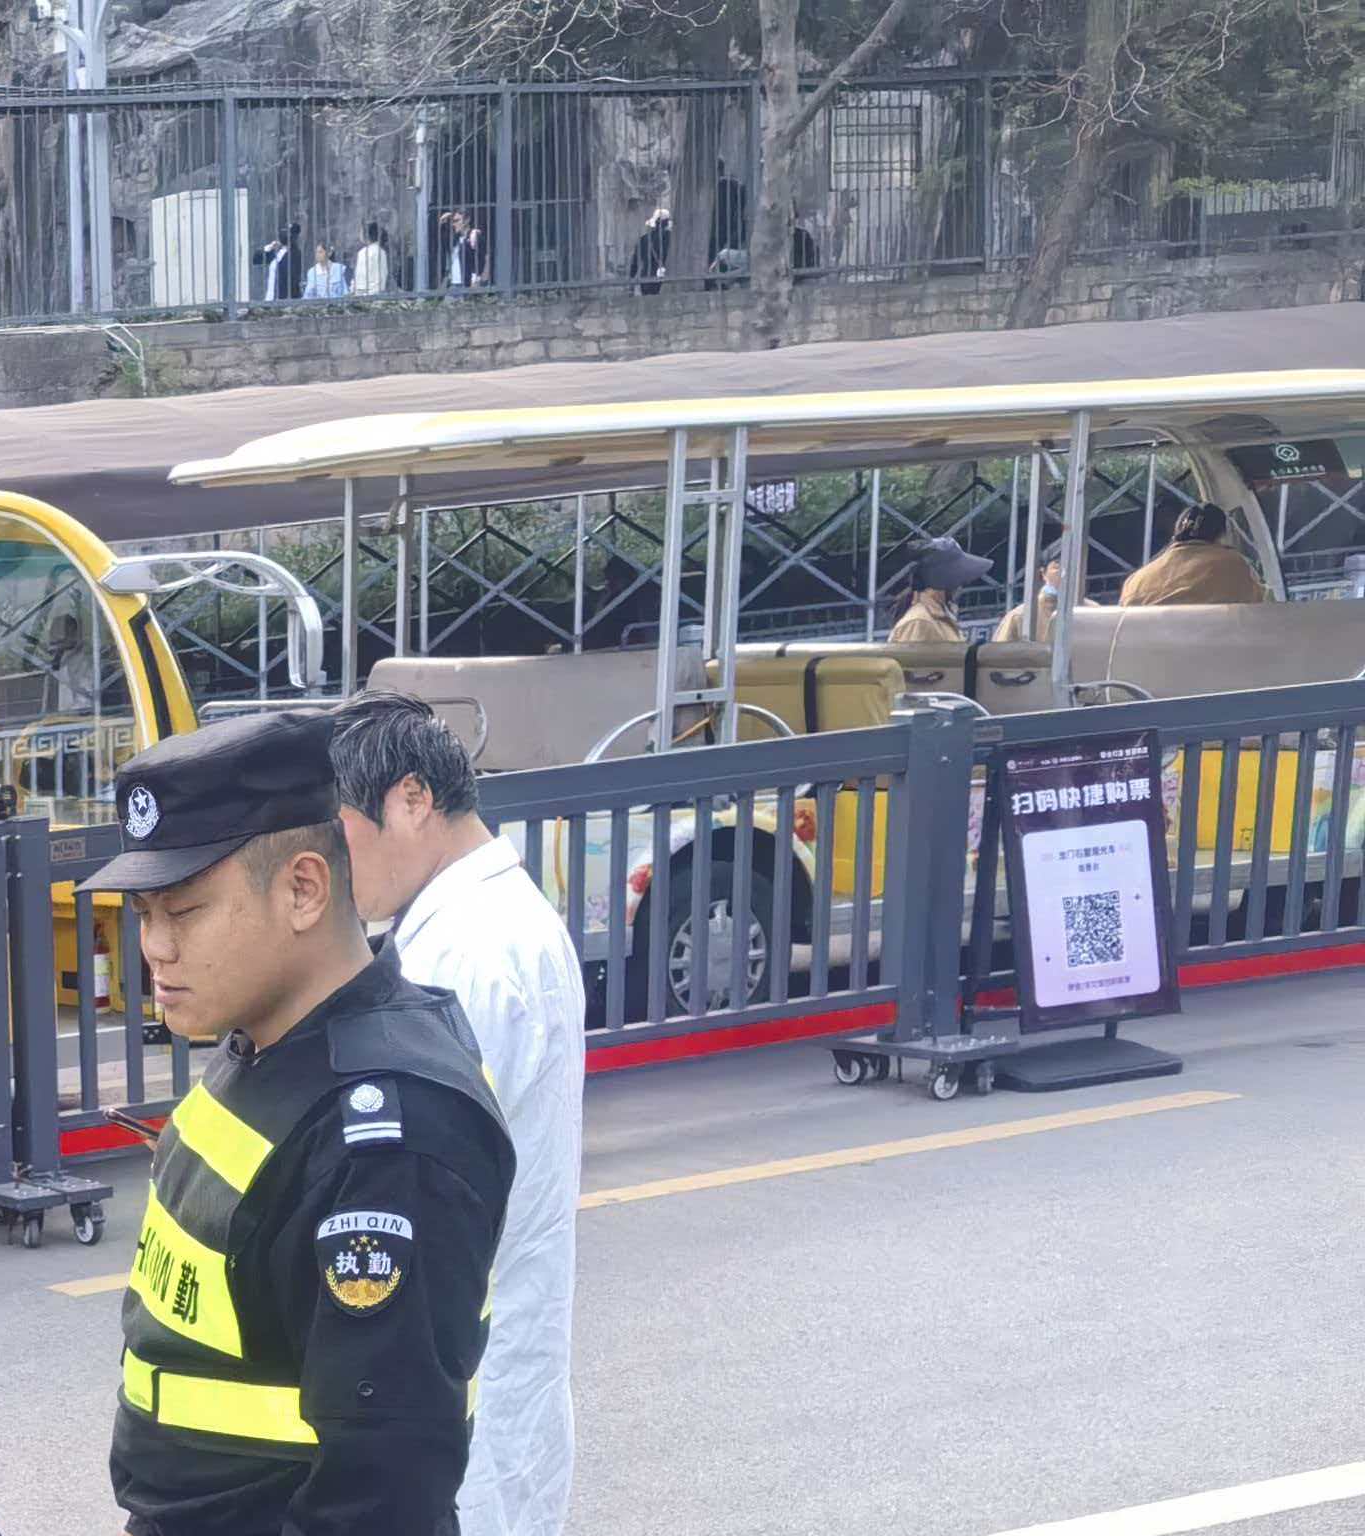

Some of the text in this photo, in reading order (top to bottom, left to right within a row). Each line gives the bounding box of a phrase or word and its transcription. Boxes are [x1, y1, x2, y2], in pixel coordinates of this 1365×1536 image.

[1010, 777, 1152, 816] 扫码快捷购票
[327, 1216, 404, 1233] ZHI QIN
[172, 1259, 200, 1325] 勤
